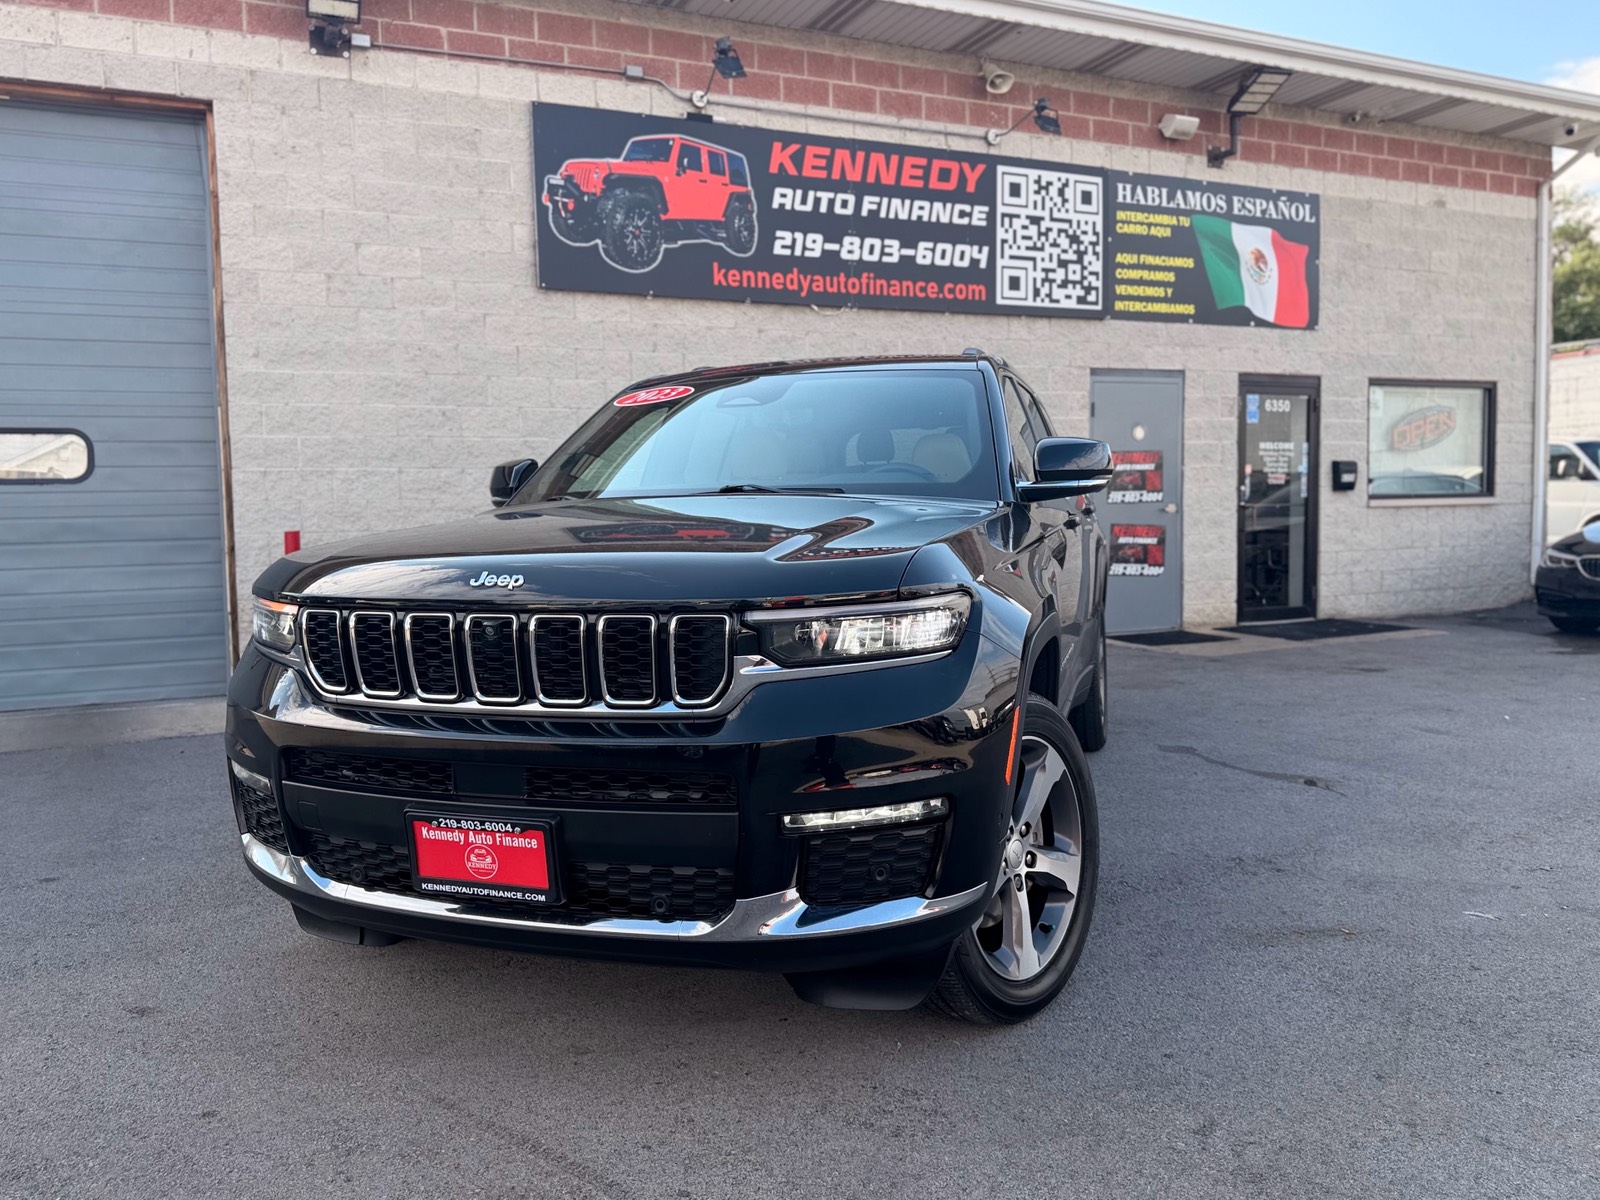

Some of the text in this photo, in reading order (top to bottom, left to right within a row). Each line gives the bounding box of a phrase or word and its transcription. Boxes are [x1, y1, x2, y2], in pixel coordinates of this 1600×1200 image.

[769, 141, 986, 193] KENNEDY
[772, 187, 990, 226] AUTO FINANCE
[1116, 183, 1316, 223] HABLAMOS ESPAÑOL
[1116, 210, 1190, 228] INTERCAMBIA TU
[1116, 222, 1171, 238] CARRO AQUI
[773, 230, 989, 269] 219-803-6004
[1115, 252, 1195, 269] AQUI FINACIAMOS
[713, 262, 986, 301] kennedyautofinance.com
[1115, 268, 1175, 282] COMPRAMOS
[1115, 284, 1173, 298] VENDEMOS Y
[1114, 300, 1195, 315] INTERCAMBIAMOS
[1265, 399, 1291, 412] 6350
[1392, 411, 1457, 449] OPEN
[470, 571, 525, 590] Jeep
[438, 818, 513, 833] 219-803-6004
[421, 827, 538, 849] Kennedy Auto Finance
[467, 861, 497, 870] KENNEDY
[421, 882, 546, 902] KENNEDYAUTOFINANCE.COM
